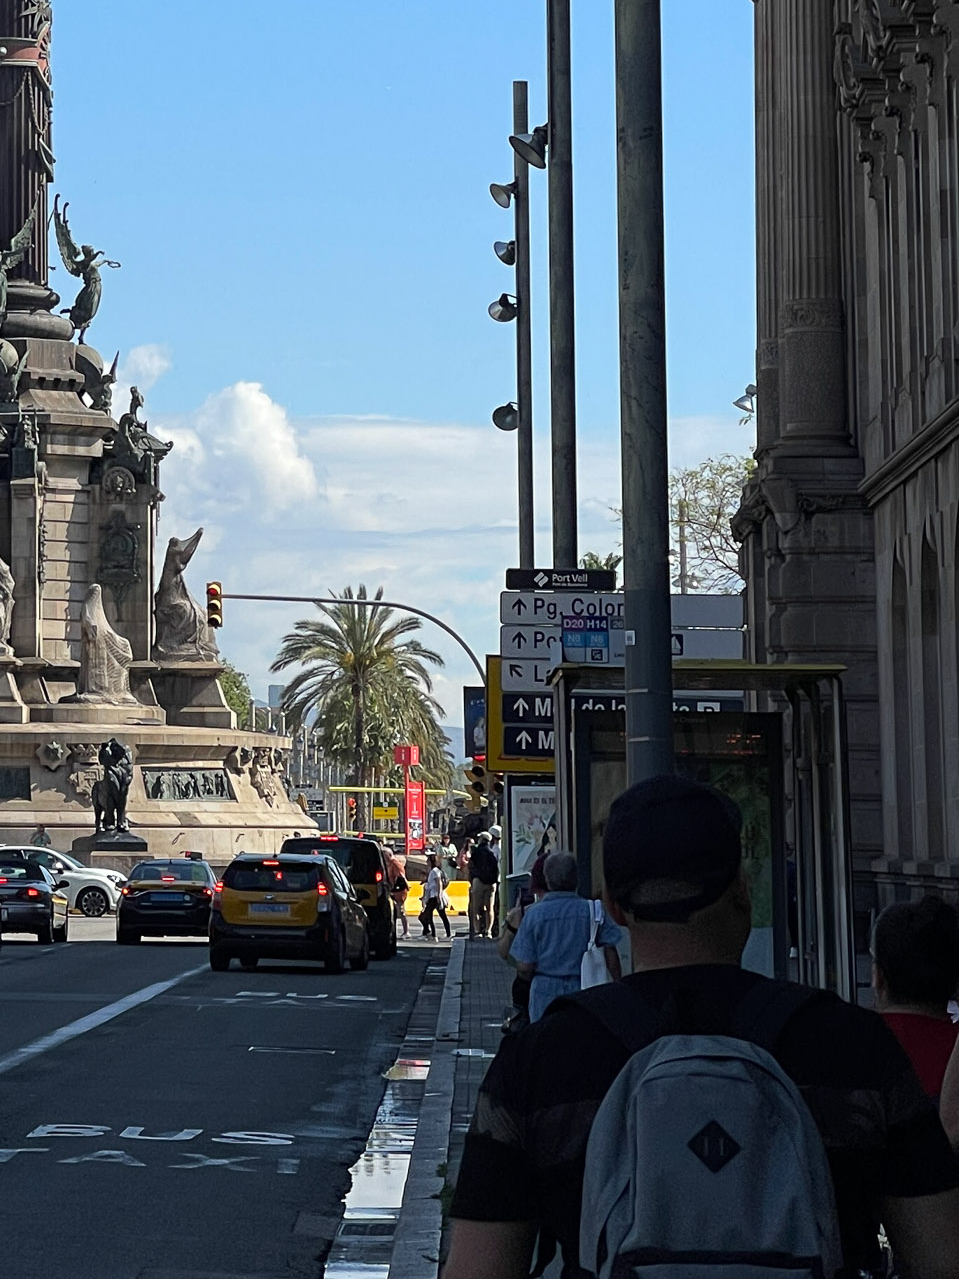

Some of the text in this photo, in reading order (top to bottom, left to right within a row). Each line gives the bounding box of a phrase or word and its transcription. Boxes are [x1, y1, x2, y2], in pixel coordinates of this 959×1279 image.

[552, 573, 588, 582] Port Vell
[563, 619, 584, 629] D20
[586, 619, 607, 629] H14
[25, 1123, 296, 1146] BUS
